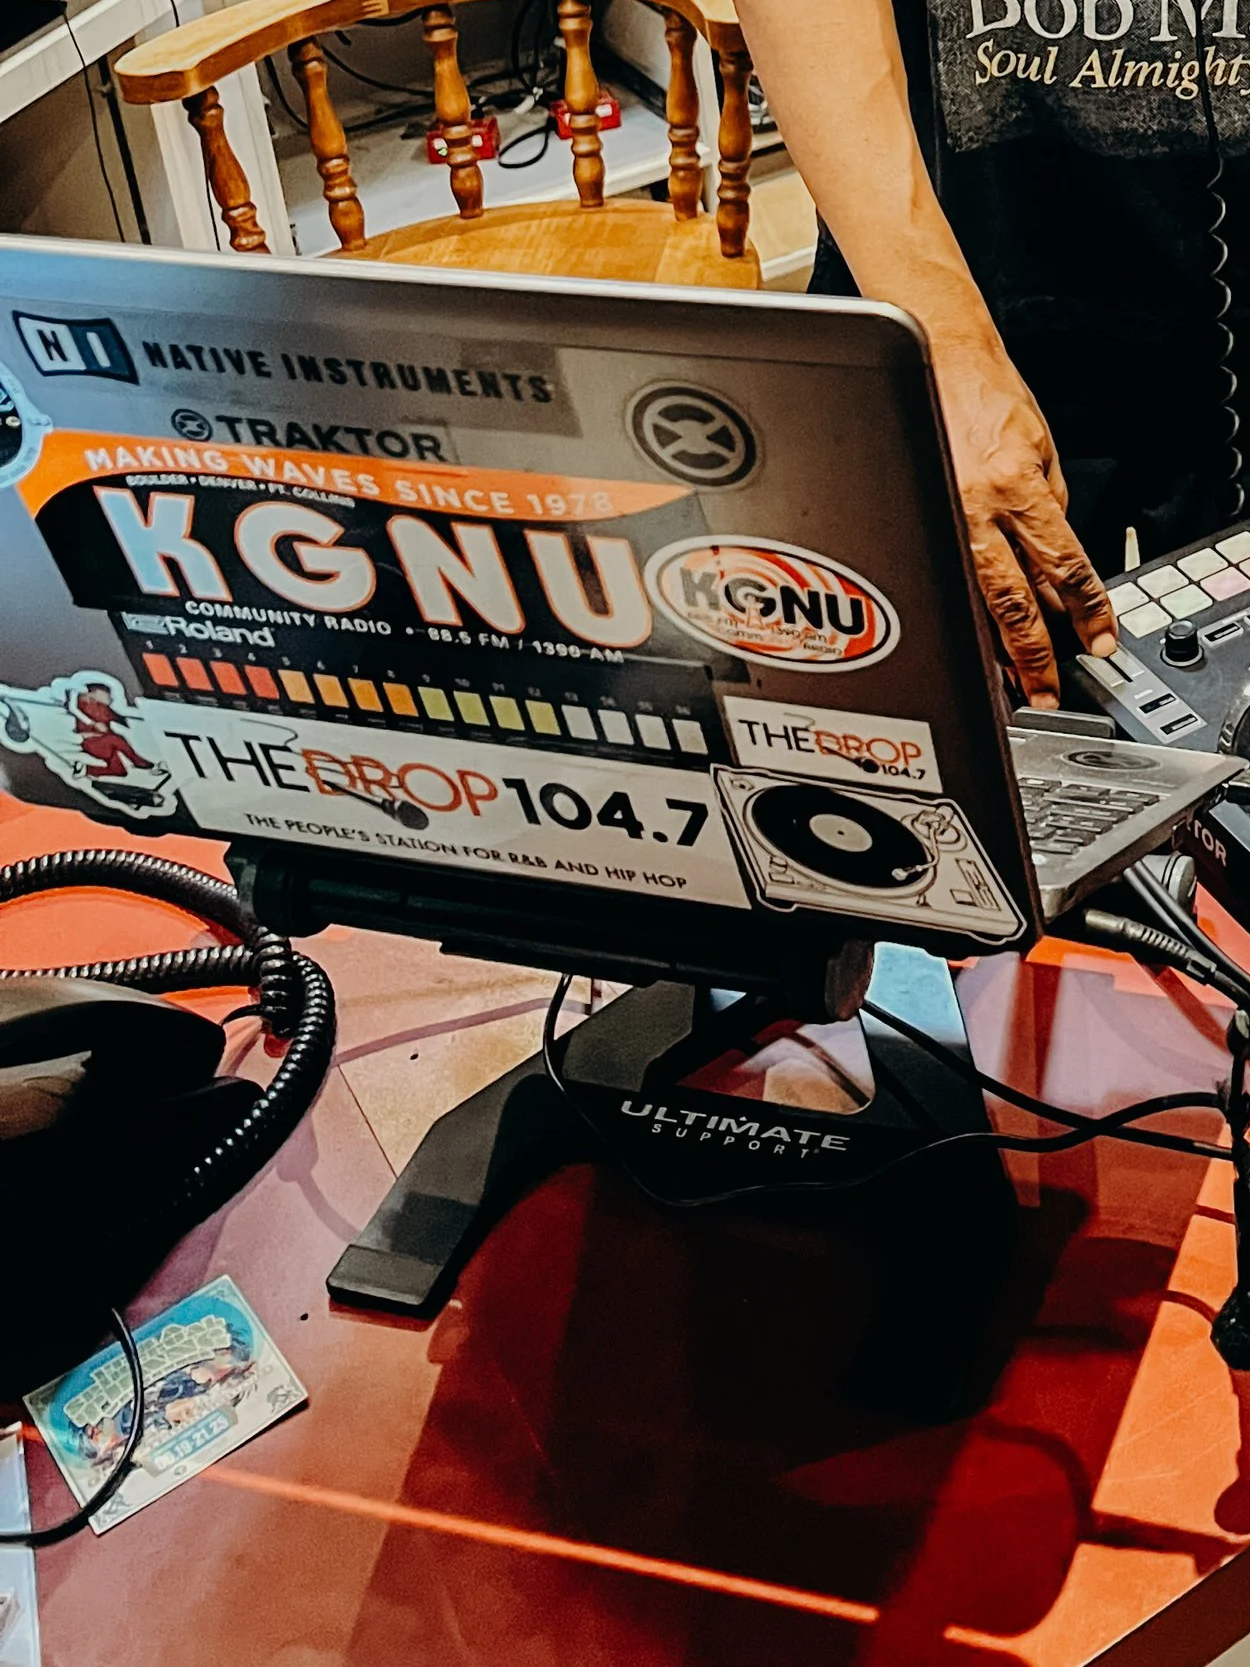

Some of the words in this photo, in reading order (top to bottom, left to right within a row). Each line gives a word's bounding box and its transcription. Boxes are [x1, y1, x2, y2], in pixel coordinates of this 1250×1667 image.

[975, 37, 1059, 86] Soul
[142, 340, 272, 380] NATIVE
[283, 352, 555, 405] INSTRUMENTS
[215, 414, 448, 463] TRAKTOR
[84, 445, 229, 473] MAKING
[241, 453, 379, 497] WAVES
[398, 478, 516, 517] SINCE
[526, 492, 615, 517] 1978
[93, 486, 653, 648] KGNU
[166, 615, 276, 648] Roland
[185, 600, 316, 629] COMMUNITY
[324, 615, 392, 636] RADIO
[478, 632, 511, 651] FM
[532, 640, 582, 659] 1390
[589, 646, 625, 664] AM
[679, 566, 866, 636] KGNU
[881, 762, 927, 781] 104.7
[503, 776, 710, 848] 104.7
[245, 812, 282, 833] THE
[285, 818, 371, 843] PEOPLE'S
[375, 831, 458, 856] STATION
[463, 844, 503, 863] FOR
[508, 852, 548, 870] R&B
[554, 858, 599, 878] AND
[605, 866, 637, 883] HIP
[643, 871, 688, 890] HOP
[620, 1100, 851, 1152] ULTIMATE
[651, 1123, 812, 1160] SUPPORT
